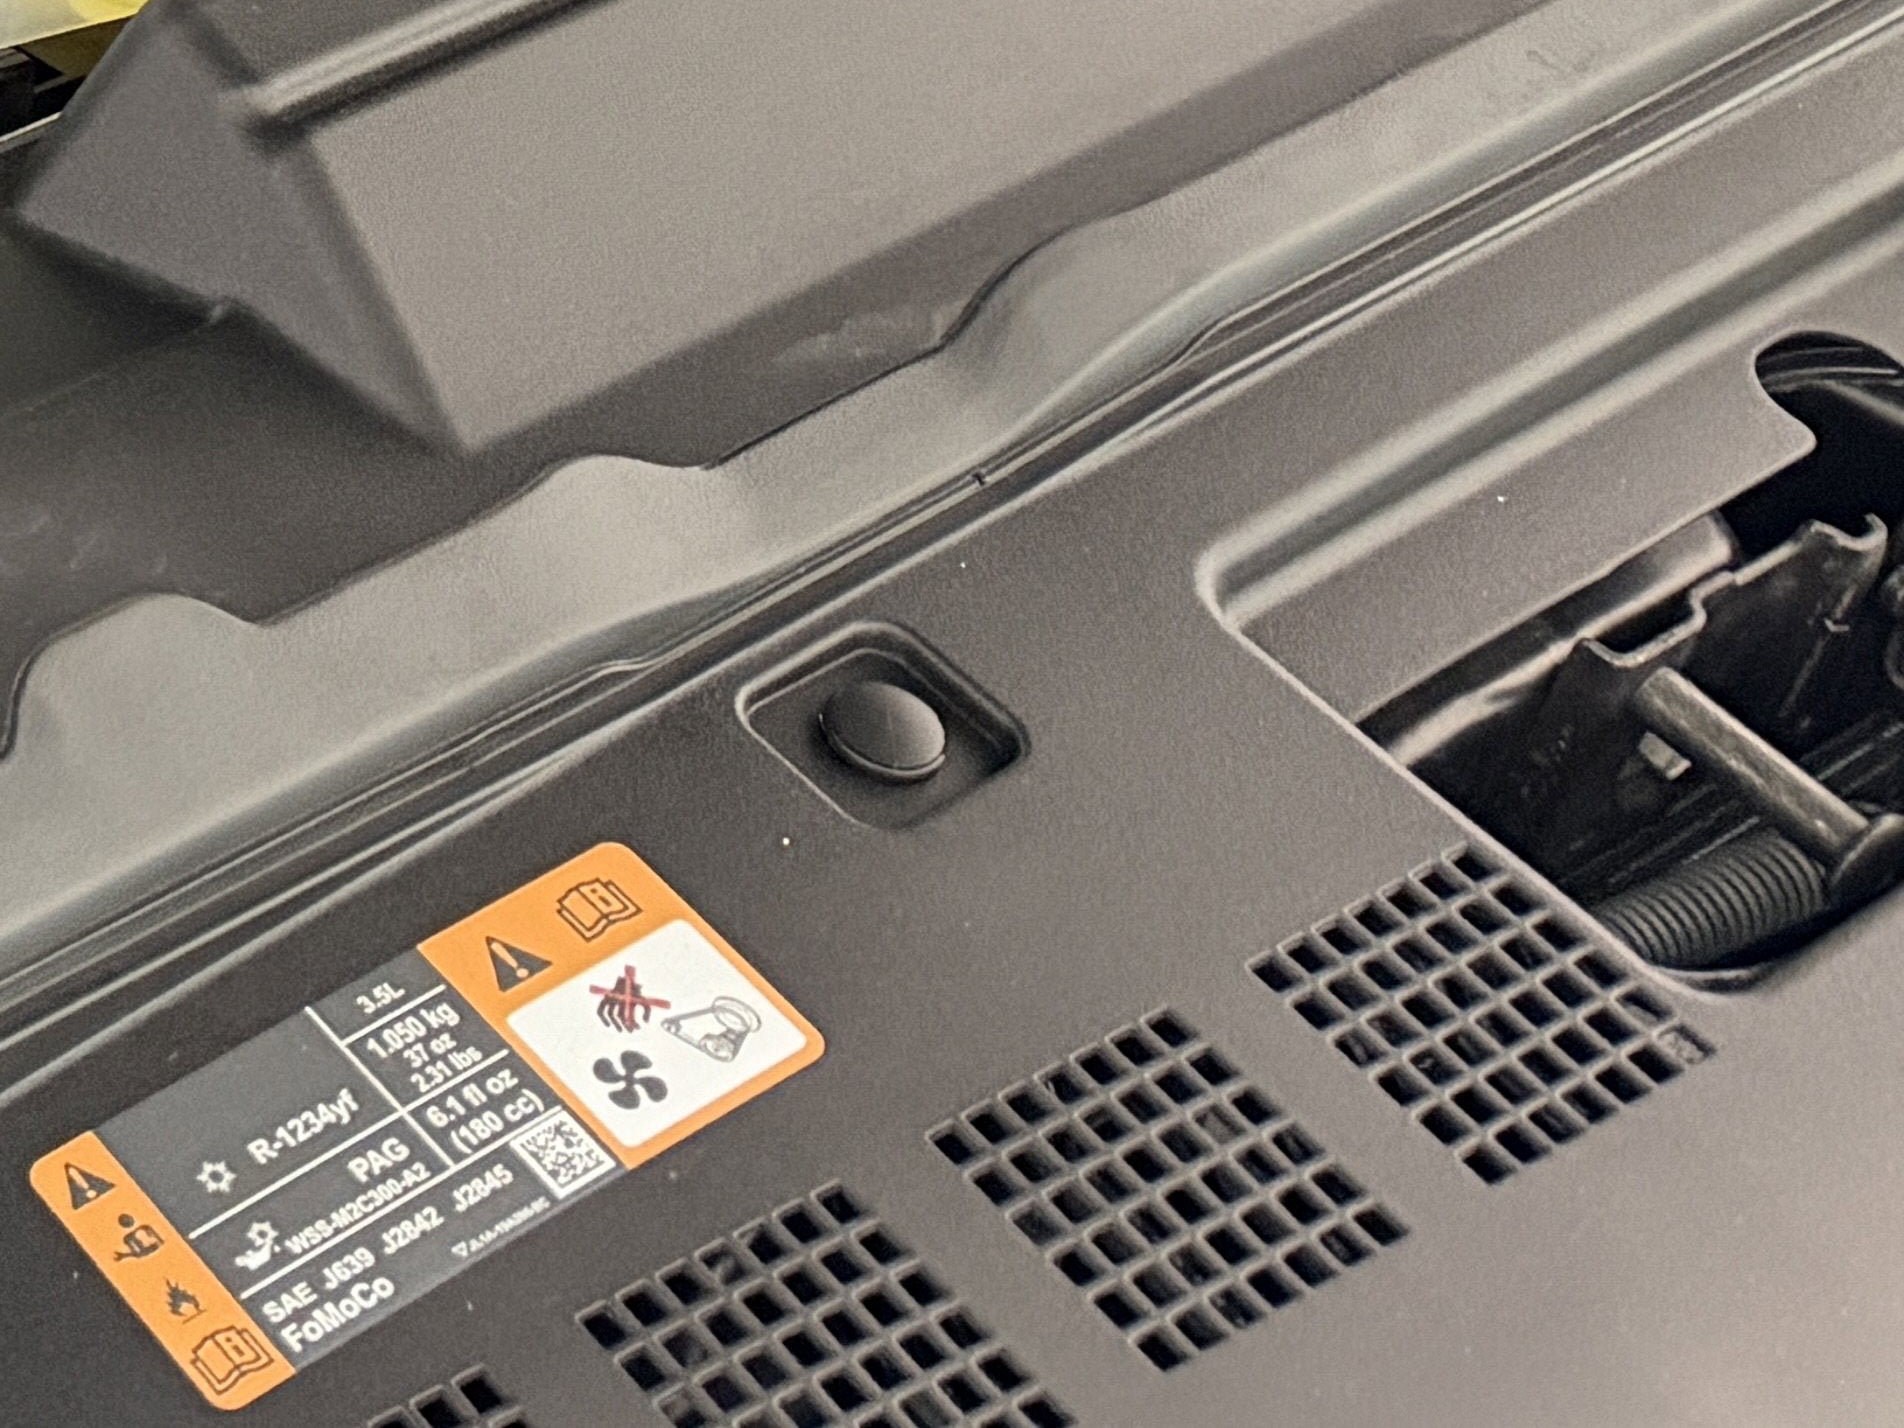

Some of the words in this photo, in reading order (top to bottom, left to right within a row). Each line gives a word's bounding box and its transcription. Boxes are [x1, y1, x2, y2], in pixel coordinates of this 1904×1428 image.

[356, 982, 405, 1013] 3.5L
[366, 1015, 426, 1058] 1.050
[419, 1002, 460, 1028] kg
[402, 1042, 429, 1068] 37
[429, 1032, 456, 1054] oz
[410, 1060, 452, 1092] 2.31
[447, 1046, 482, 1070] lbs
[425, 1095, 465, 1127] 6.1
[462, 1082, 487, 1106] fl
[485, 1068, 518, 1094] oz
[247, 1088, 358, 1163] R-1234yf
[450, 1110, 503, 1153] (180
[503, 1088, 544, 1122] cc)
[347, 1137, 409, 1182] PAG
[285, 1162, 429, 1253] WSS-M2C300-A2
[262, 1281, 317, 1322] SAE
[322, 1246, 375, 1289] J639
[381, 1205, 444, 1254] J2842
[452, 1163, 513, 1211] J2845
[280, 1277, 394, 1352] FoMoCo
